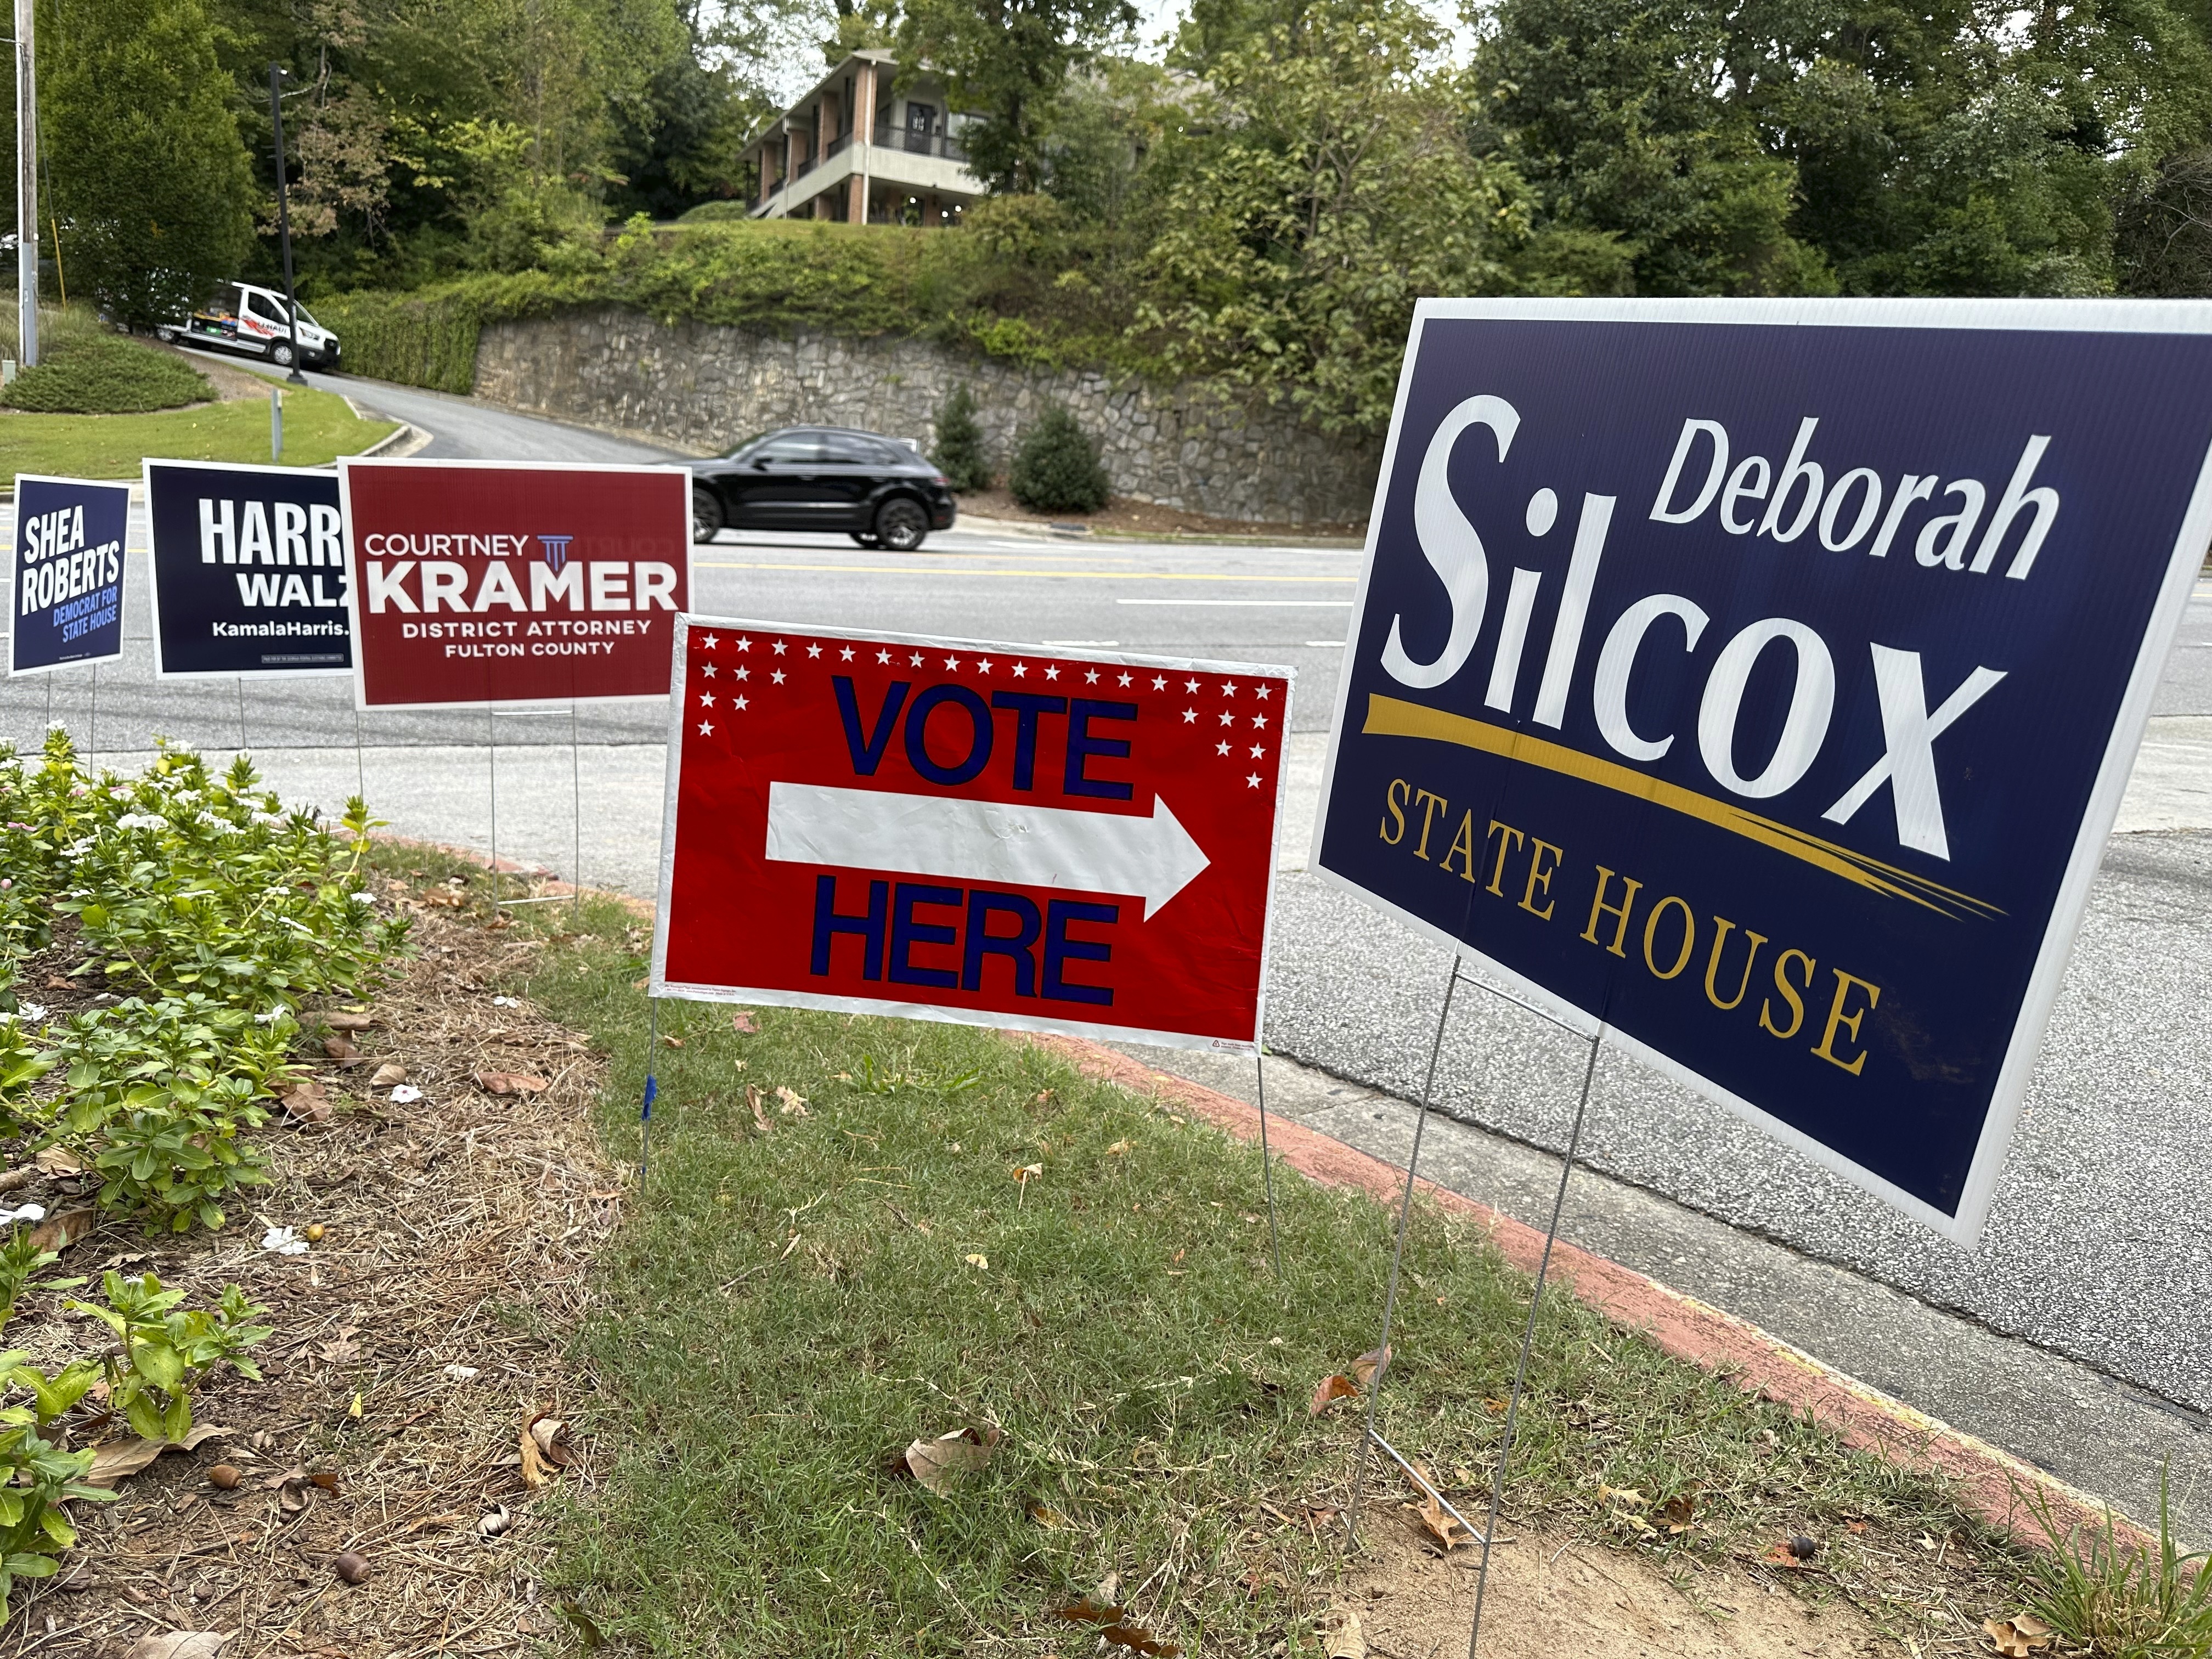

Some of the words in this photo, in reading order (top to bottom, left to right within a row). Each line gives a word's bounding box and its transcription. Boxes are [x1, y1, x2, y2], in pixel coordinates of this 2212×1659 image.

[257, 322, 287, 335] U-HAUL
[1649, 417, 2059, 580] Deborah
[24, 505, 84, 563] SHEA
[199, 499, 342, 566] HARR
[365, 534, 529, 556] COURTNEY
[22, 540, 119, 616] ROBERTS
[366, 561, 679, 614] KRAMER
[53, 592, 100, 627] DEMOCRAT
[101, 585, 117, 608] FOR
[63, 617, 88, 642] STATE
[90, 605, 116, 631] HOUSE
[213, 620, 349, 636] KamalaHarris.
[403, 622, 517, 638] DISTRICT
[527, 620, 651, 636] ATTORNEY
[1380, 395, 2008, 861] Silcox
[446, 644, 524, 657] FULTON
[532, 642, 614, 656] COUNTY
[833, 677, 1136, 799] VOTE
[812, 876, 1117, 1005] HERE
[1380, 780, 1562, 919] STATE
[1581, 866, 1880, 1075] HOUSE
